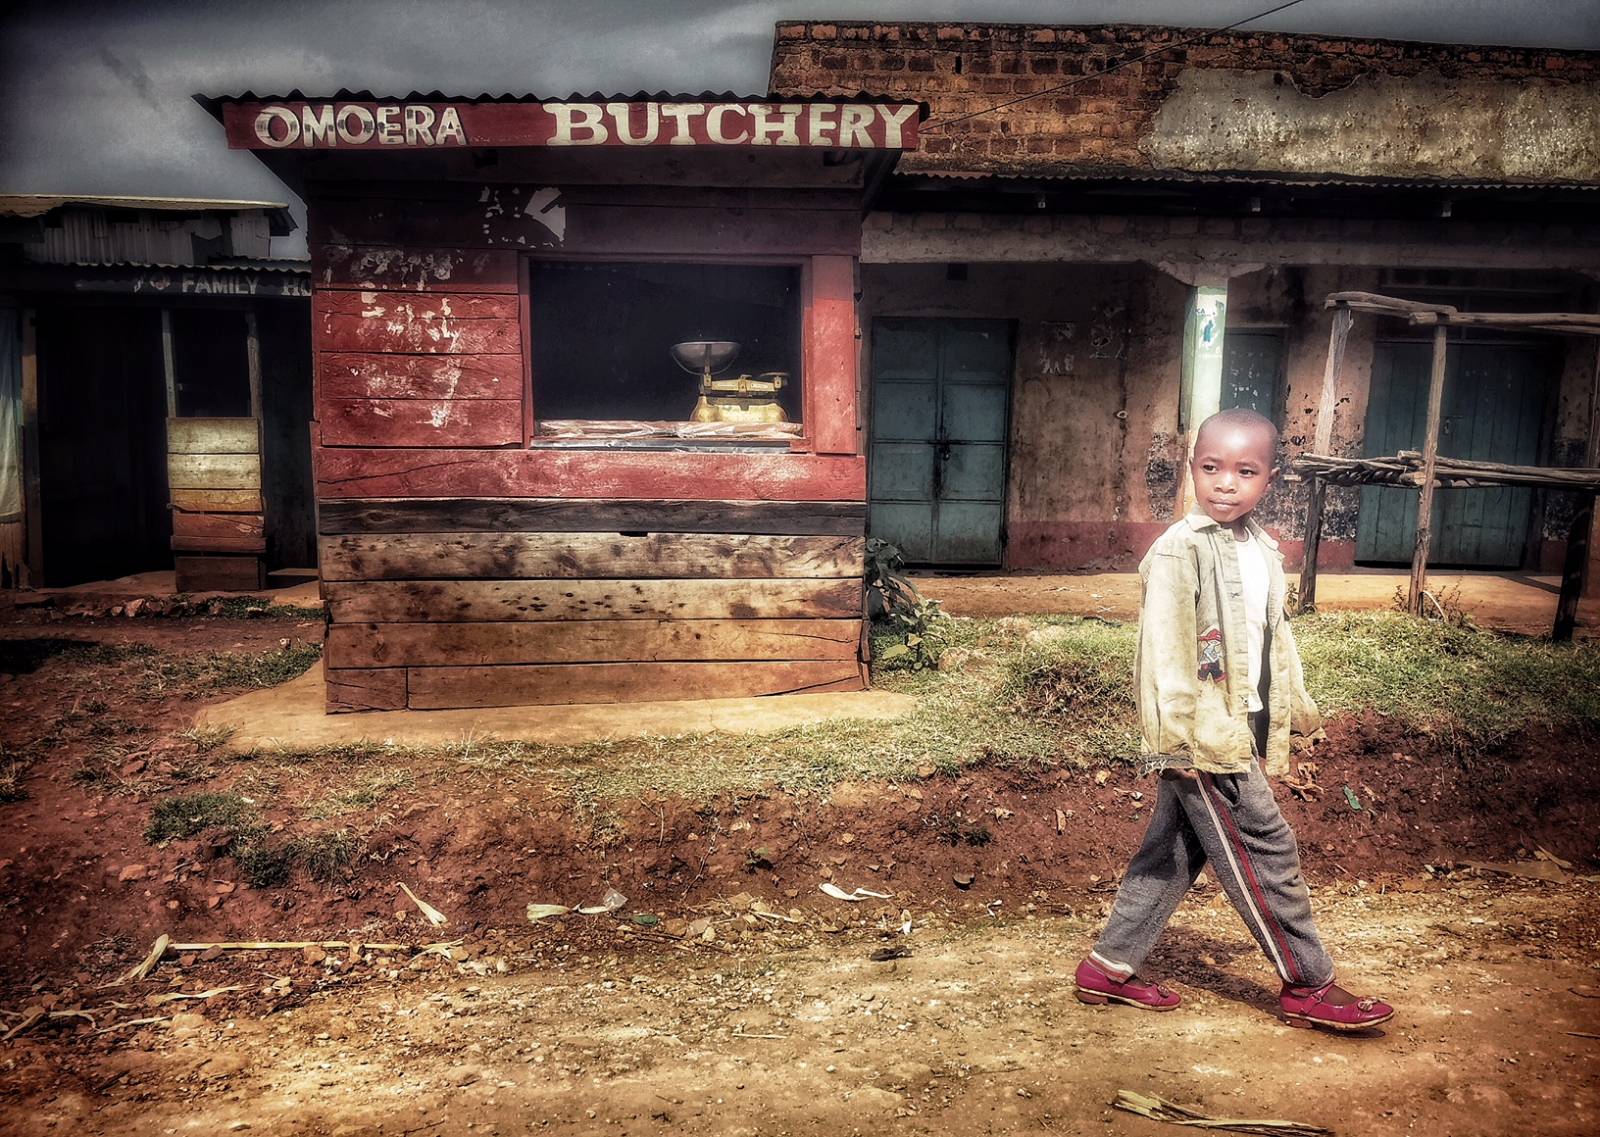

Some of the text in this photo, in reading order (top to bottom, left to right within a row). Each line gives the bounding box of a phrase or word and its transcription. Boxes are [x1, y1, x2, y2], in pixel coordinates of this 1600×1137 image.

[254, 102, 919, 149] OMOERA BUTCHERY
[181, 273, 258, 295] FAMILY
